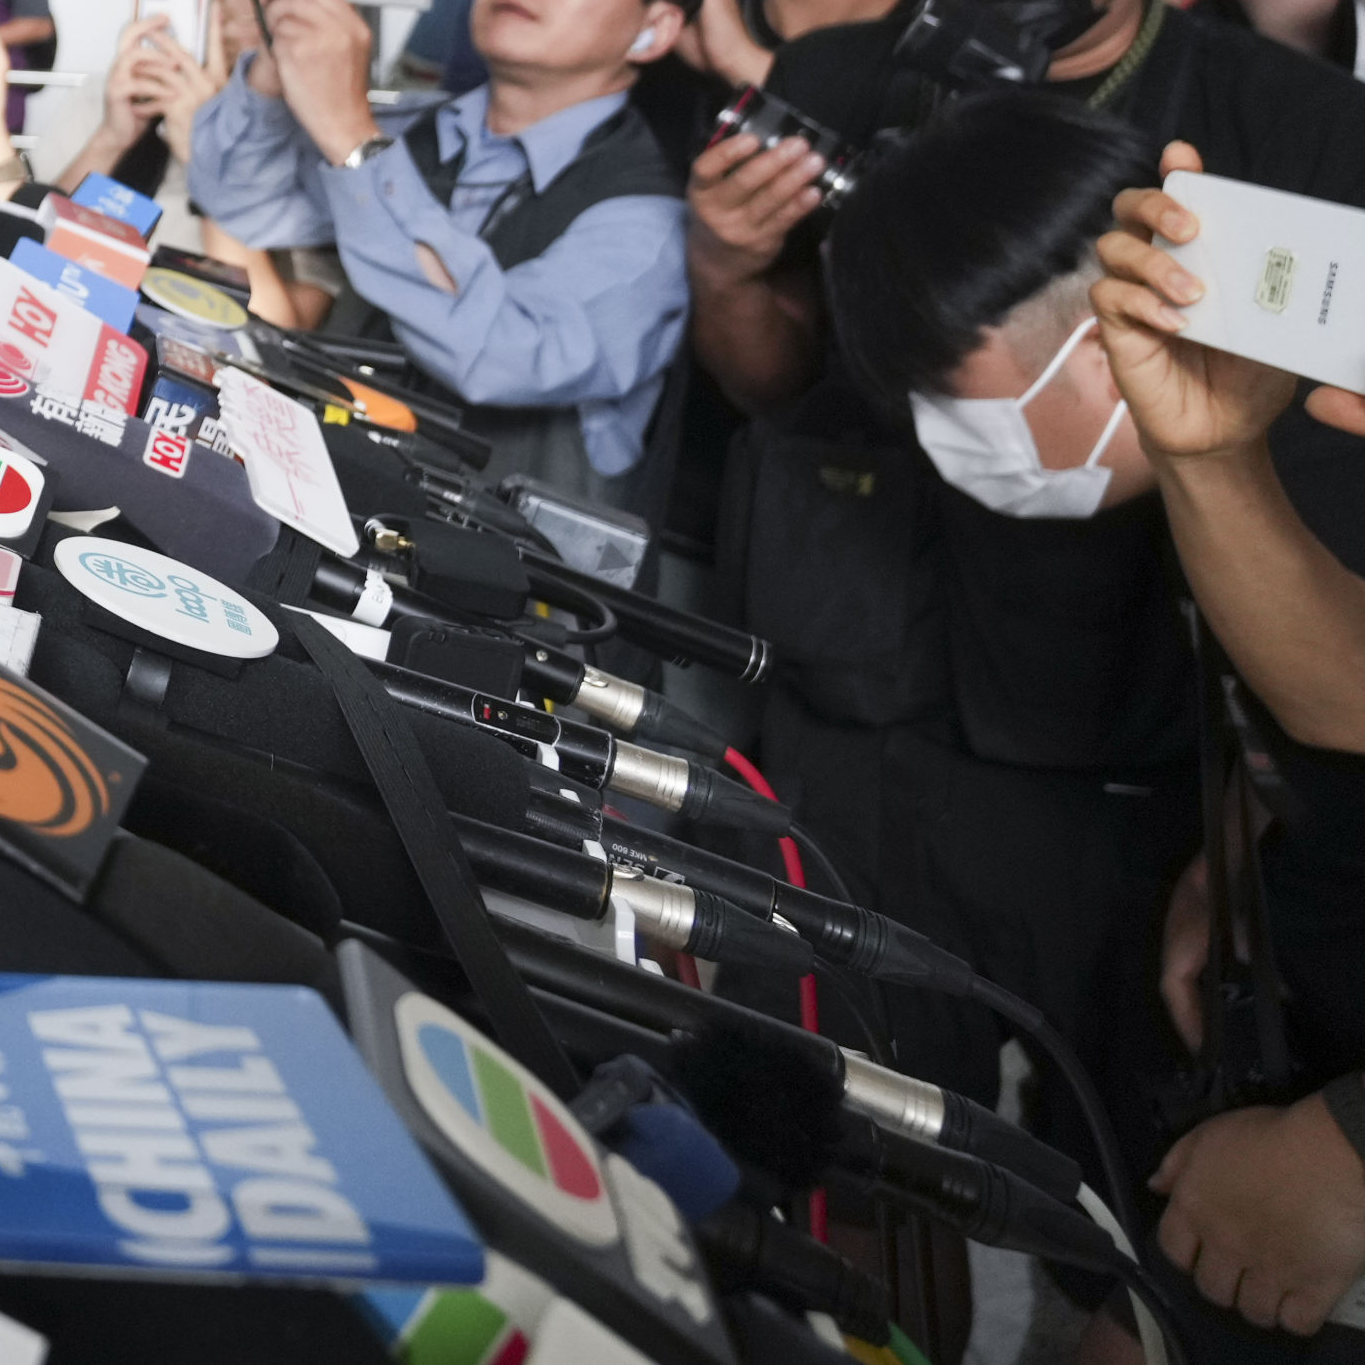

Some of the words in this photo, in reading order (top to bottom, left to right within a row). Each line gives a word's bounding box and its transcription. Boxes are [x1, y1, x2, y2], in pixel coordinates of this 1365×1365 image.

[8, 286, 58, 348] HOY
[1317, 262, 1339, 325] SAMSUNG
[27, 1004, 232, 1239] CHINA
[137, 1009, 371, 1243] DAILY
